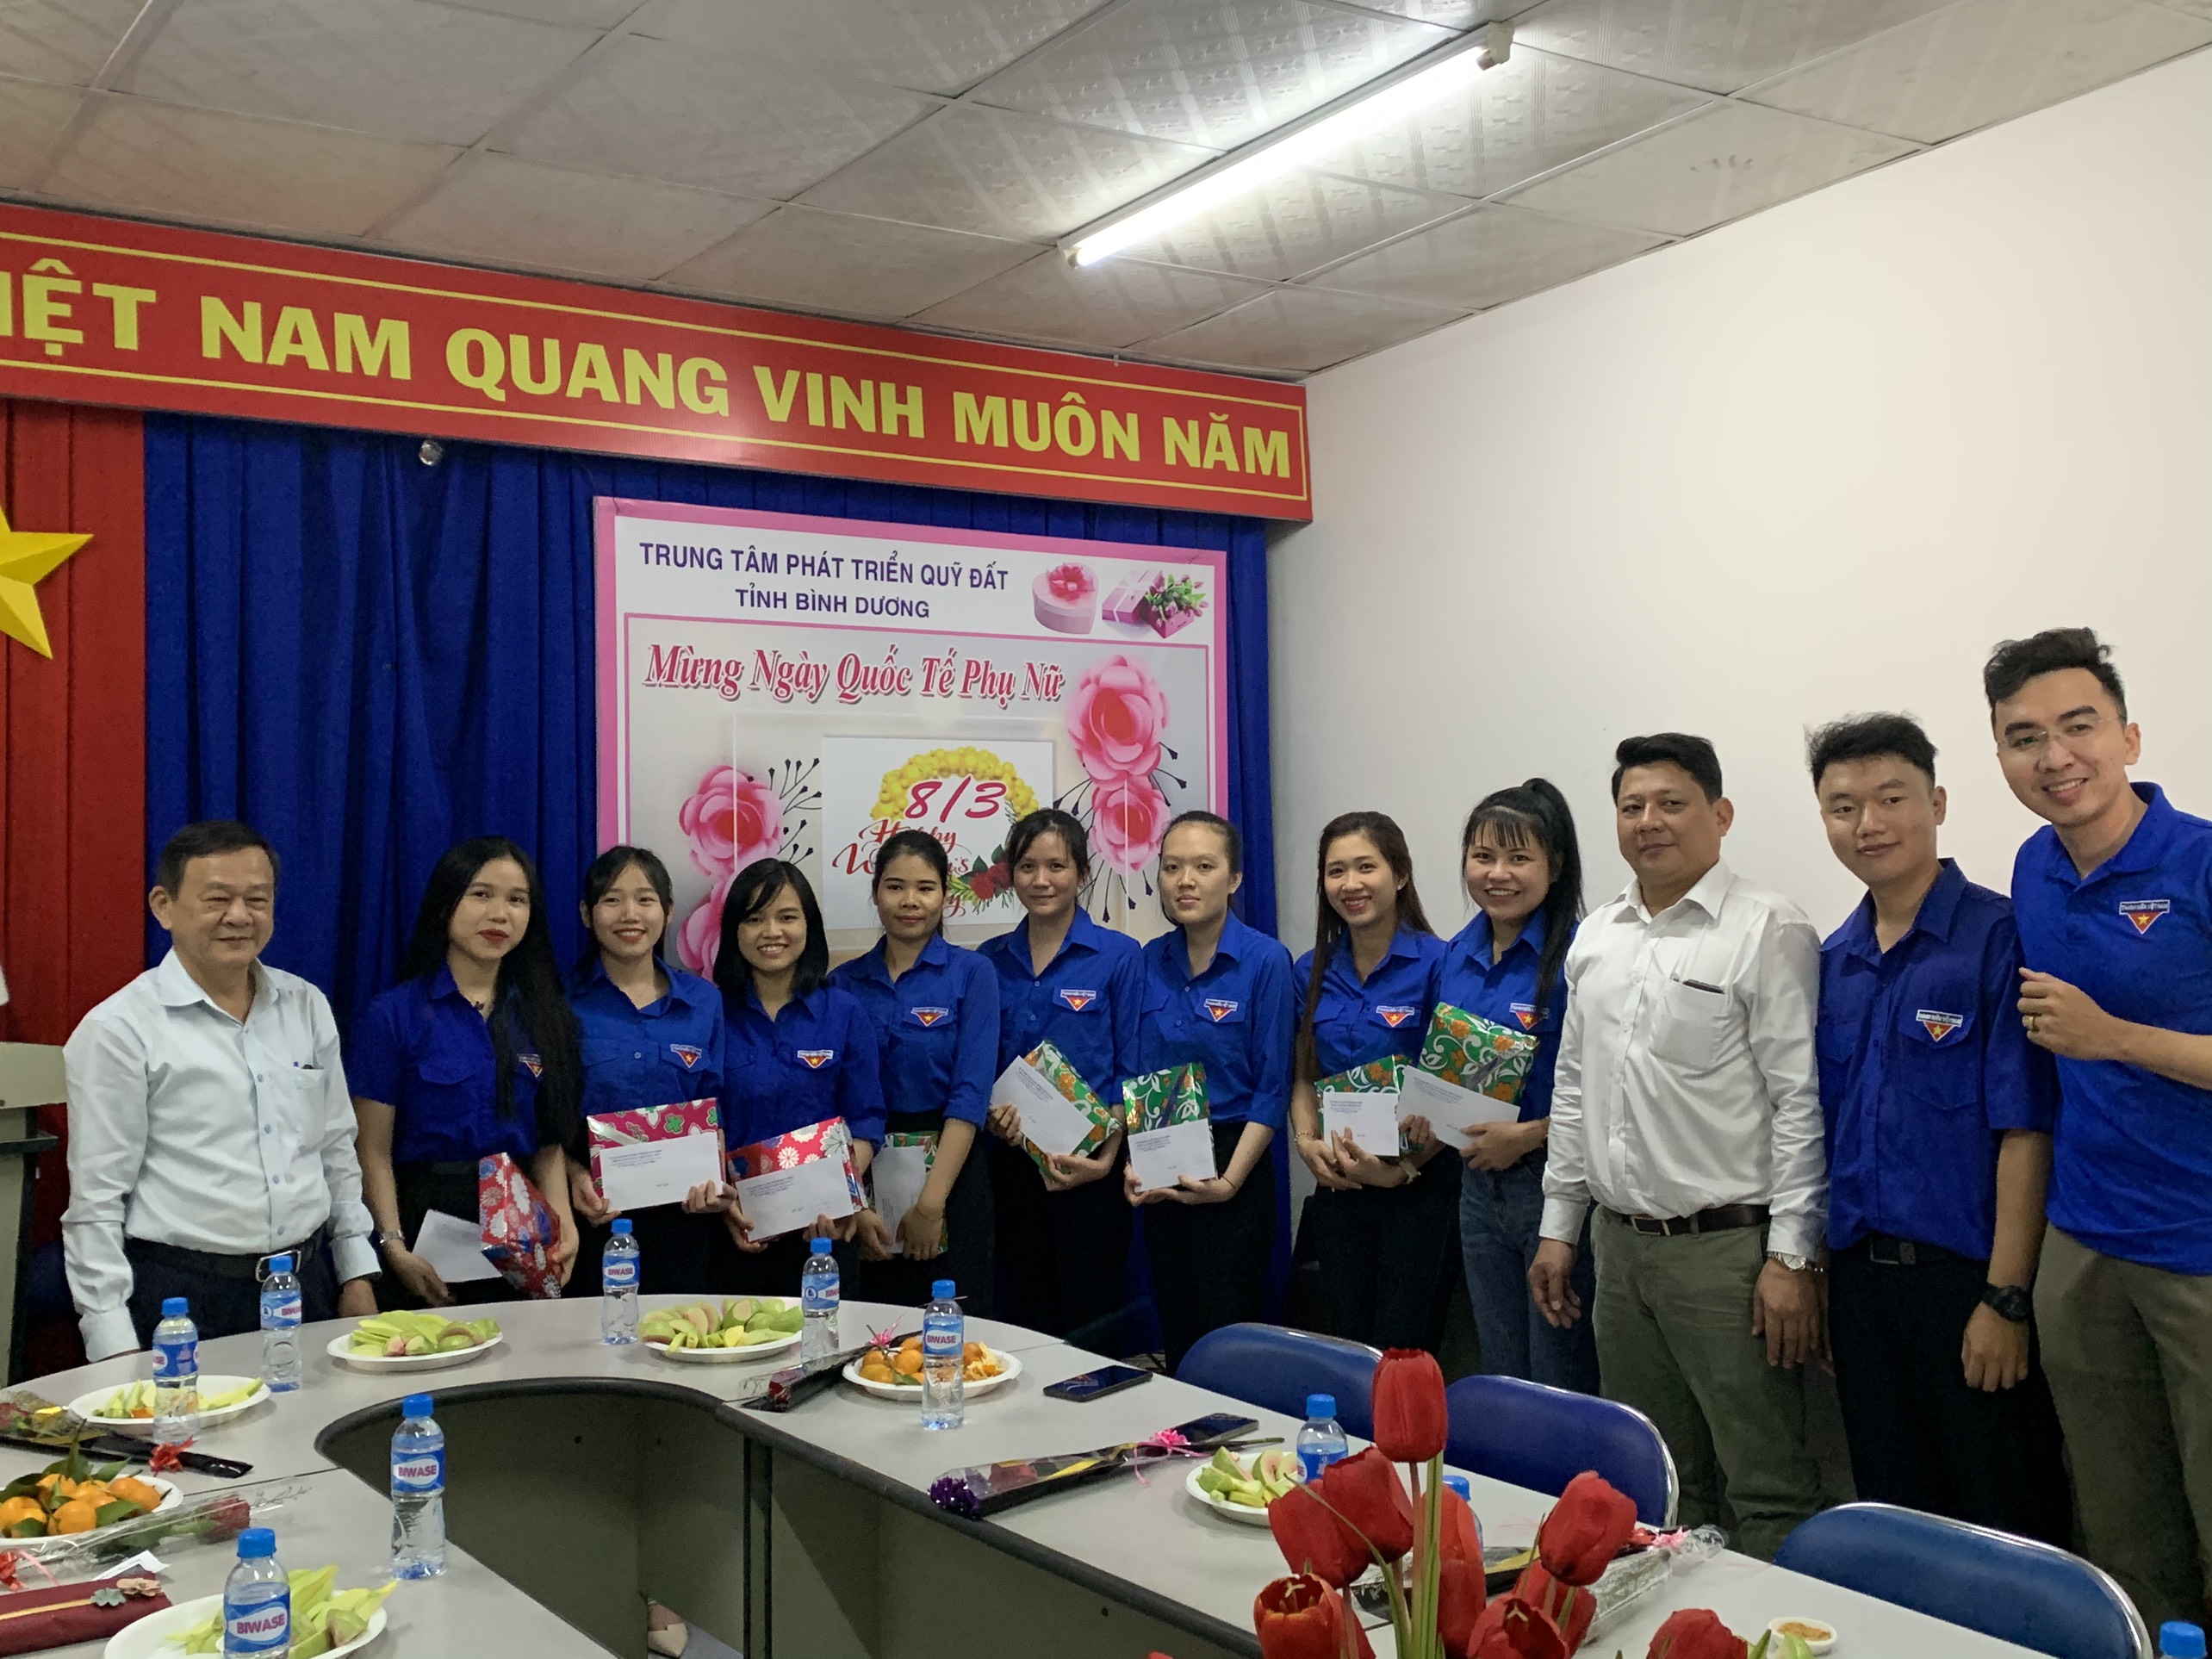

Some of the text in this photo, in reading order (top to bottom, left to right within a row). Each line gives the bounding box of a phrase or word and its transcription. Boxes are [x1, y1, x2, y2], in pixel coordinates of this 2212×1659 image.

[201, 295, 412, 381] NAM
[445, 328, 730, 416] QUANG
[753, 365, 925, 439] VINH
[954, 392, 1140, 462] MUÔN
[1164, 413, 1290, 478] NĂM
[639, 542, 1009, 590] TRUNG TÂM PHÁT TRIỂN QUỸ ĐẤT
[735, 581, 930, 618] TỈNH BÌNH DƯƠNG
[644, 643, 1064, 706] Mừng Ngày Quốc Tế Phụ Nữ
[904, 775, 1007, 823] 8/3
[926, 1334, 956, 1344] BIWASE
[398, 1464, 437, 1478] BIWASE
[236, 1612, 286, 1635] BIWASE
